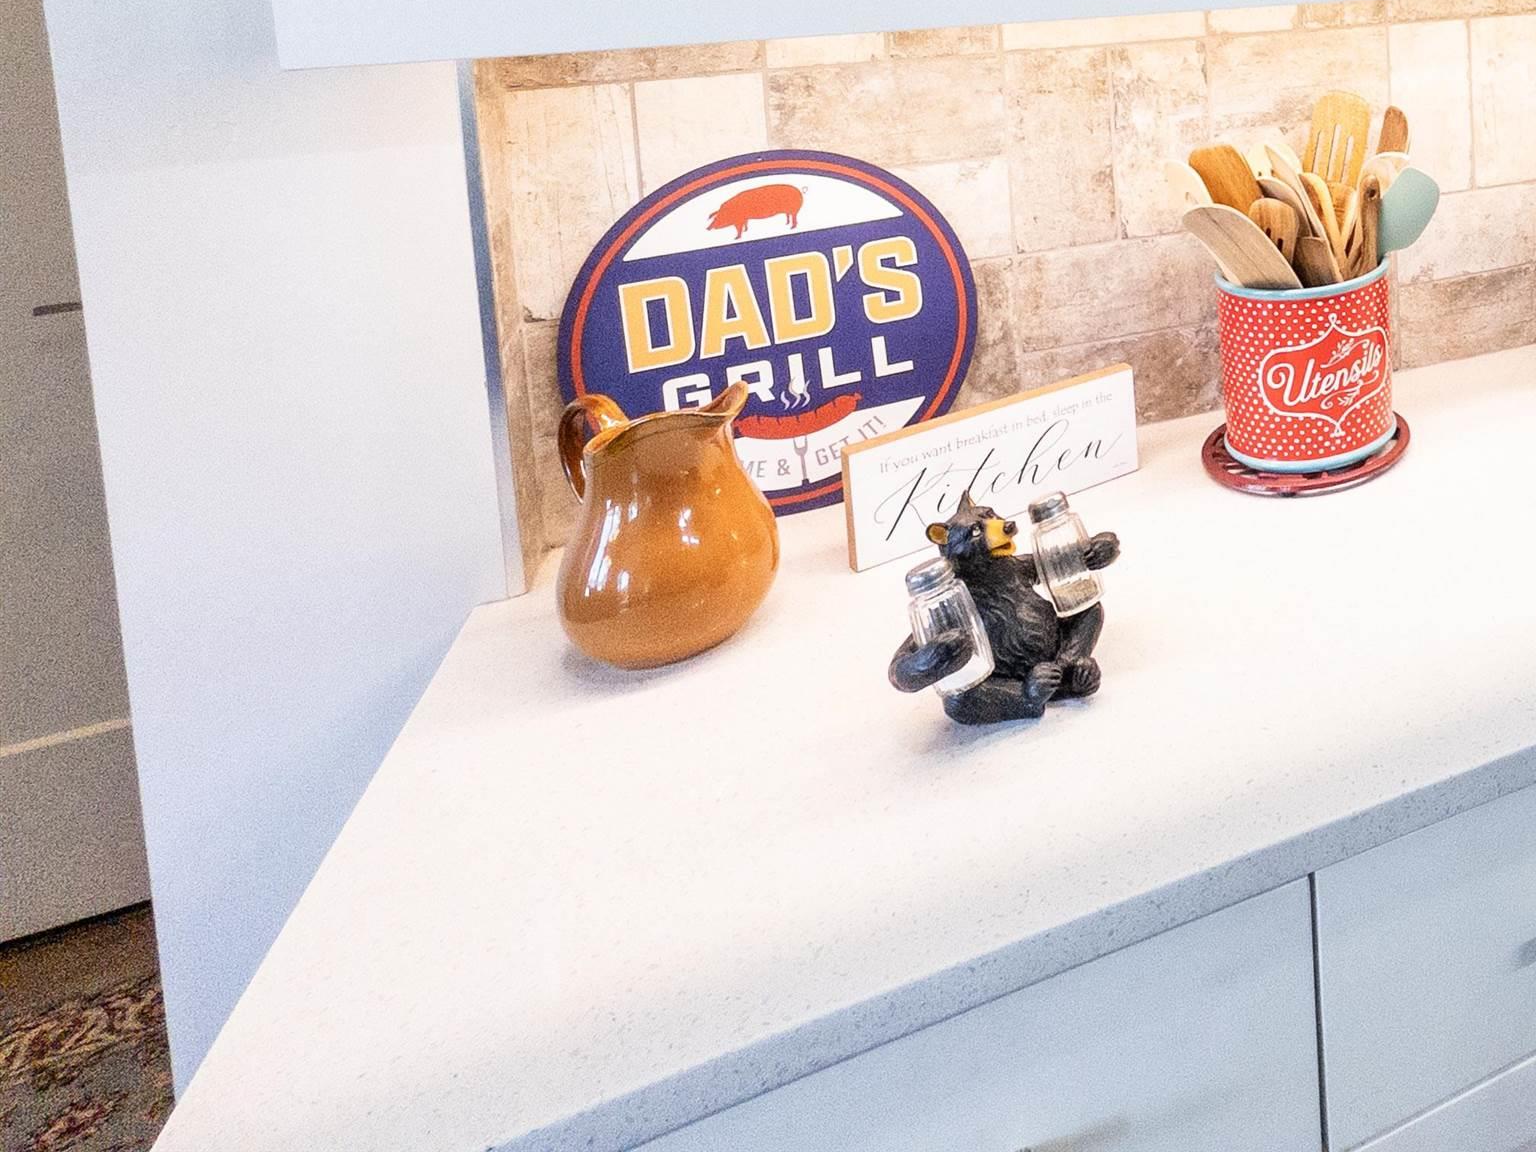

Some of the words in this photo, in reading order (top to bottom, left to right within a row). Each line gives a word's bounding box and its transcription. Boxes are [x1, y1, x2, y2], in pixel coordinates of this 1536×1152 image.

[618, 236, 923, 374] DAD'S
[662, 335, 915, 412] GRILL
[1266, 342, 1384, 406] Utensils
[879, 456, 893, 474] If
[892, 456, 919, 472] you
[921, 441, 953, 460] want
[955, 423, 1009, 449] breakfast
[1012, 421, 1024, 432] in
[1052, 403, 1080, 419] sleep
[1082, 398, 1093, 409] in
[1095, 391, 1114, 405] the
[873, 418, 1123, 541] Kitchen
